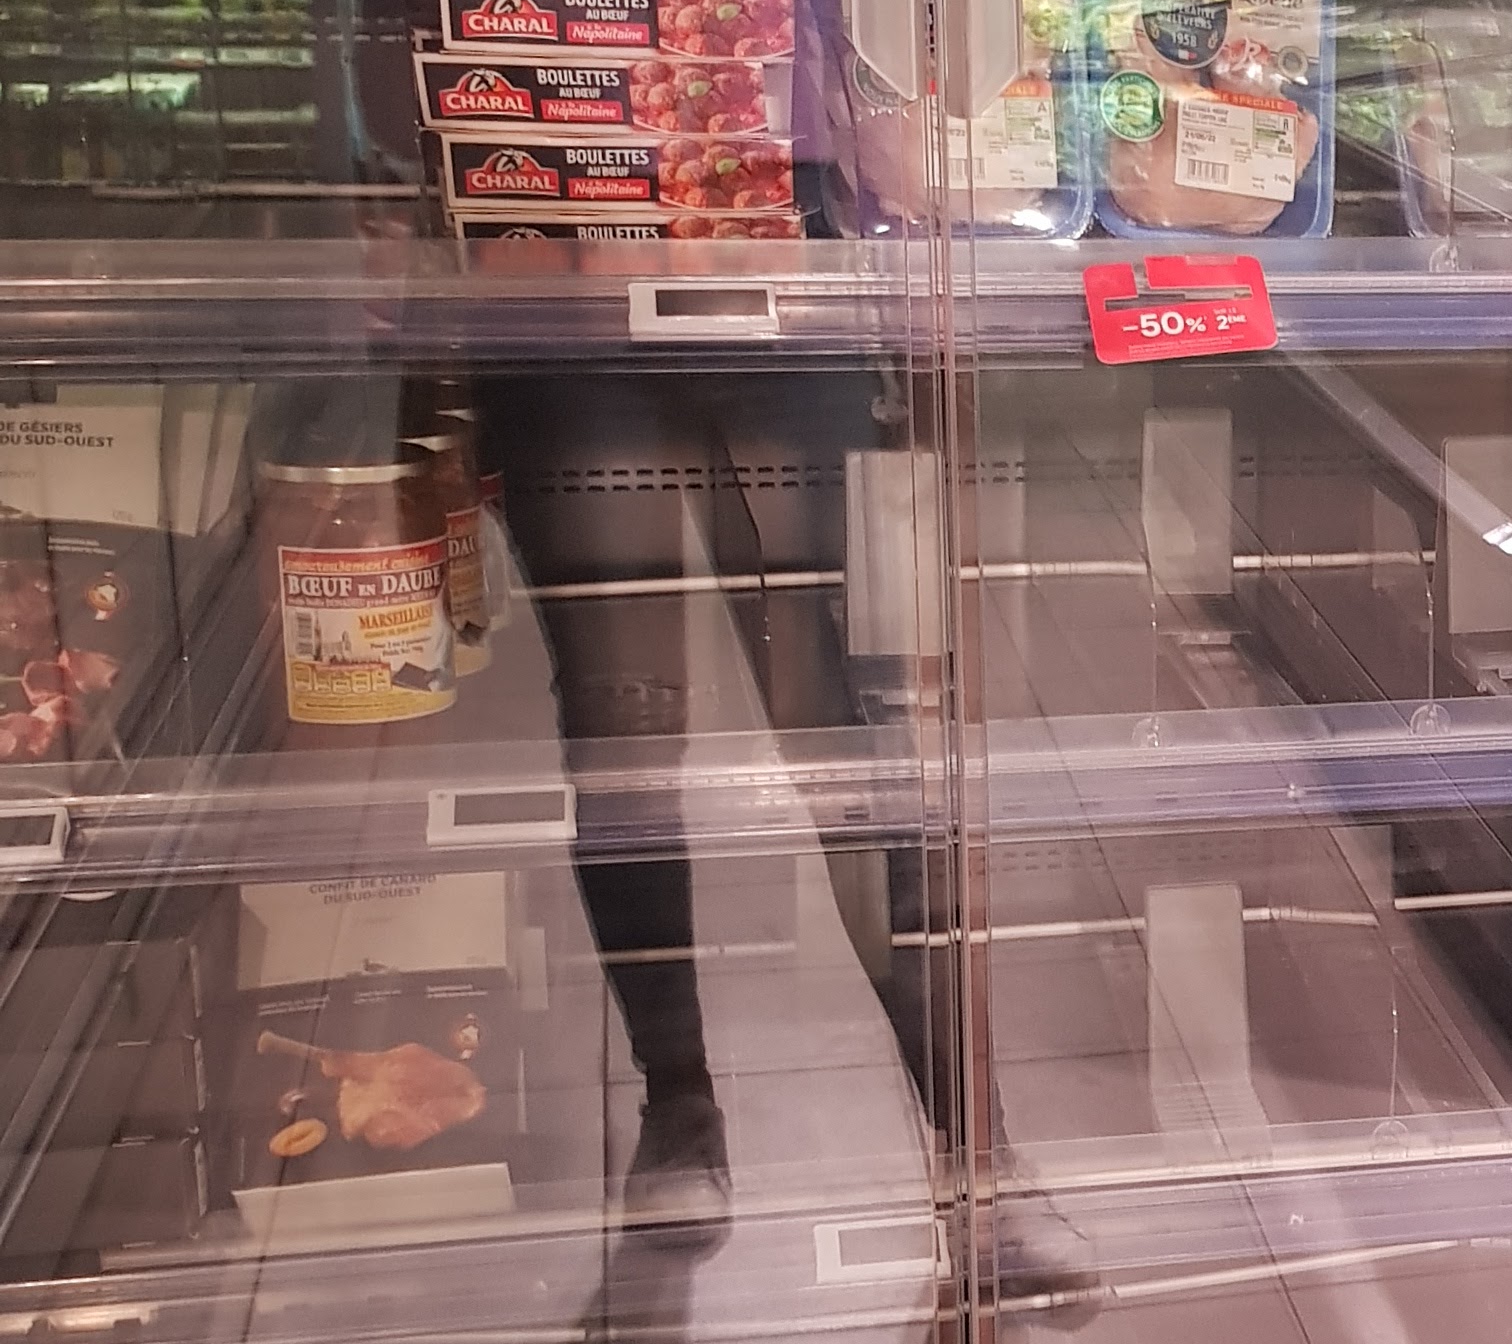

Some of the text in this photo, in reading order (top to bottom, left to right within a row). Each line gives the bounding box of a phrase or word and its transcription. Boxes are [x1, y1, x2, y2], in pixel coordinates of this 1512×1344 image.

[468, 14, 554, 33] CHARAL
[585, 9, 628, 22] AU BŒUF
[571, 25, 643, 43] Napolitaine
[1171, 31, 1198, 47] 1958
[536, 68, 620, 87] BOULETTES
[446, 93, 529, 111] CHARAL
[558, 87, 573, 99] AU
[547, 102, 617, 120] Napolitaine
[566, 149, 650, 165] BOULETTES
[586, 166, 601, 177] AU
[471, 172, 556, 190] CHARAL
[574, 181, 644, 199] Napolitaine
[577, 226, 660, 240] BOULETTES
[1122, 311, 1207, 338] -50%
[19, 419, 84, 434] GÉSIERS
[24, 434, 115, 448] SUD-OUEST
[287, 574, 352, 598] BŒUF
[358, 584, 376, 597] EN
